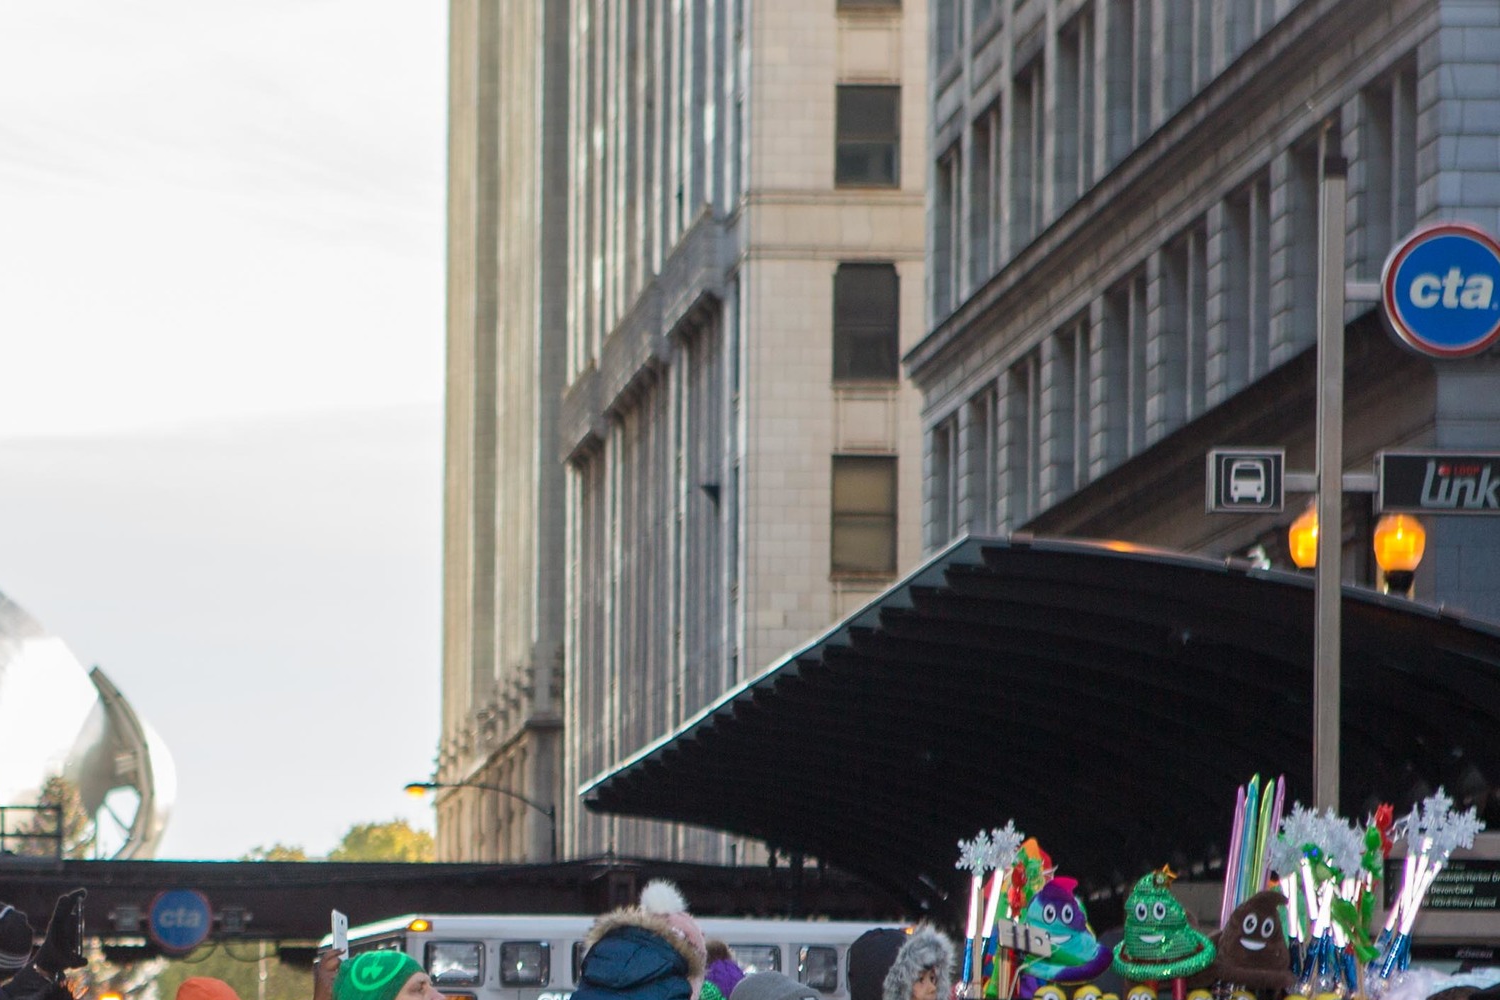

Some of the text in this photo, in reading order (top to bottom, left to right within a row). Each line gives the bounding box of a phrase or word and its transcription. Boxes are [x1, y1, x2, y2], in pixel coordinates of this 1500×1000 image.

[1409, 267, 1494, 310] cta
[1454, 464, 1480, 476] LOOP
[1421, 458, 1500, 508] Link
[1435, 870, 1464, 883] andolph
[160, 907, 200, 928] cta
